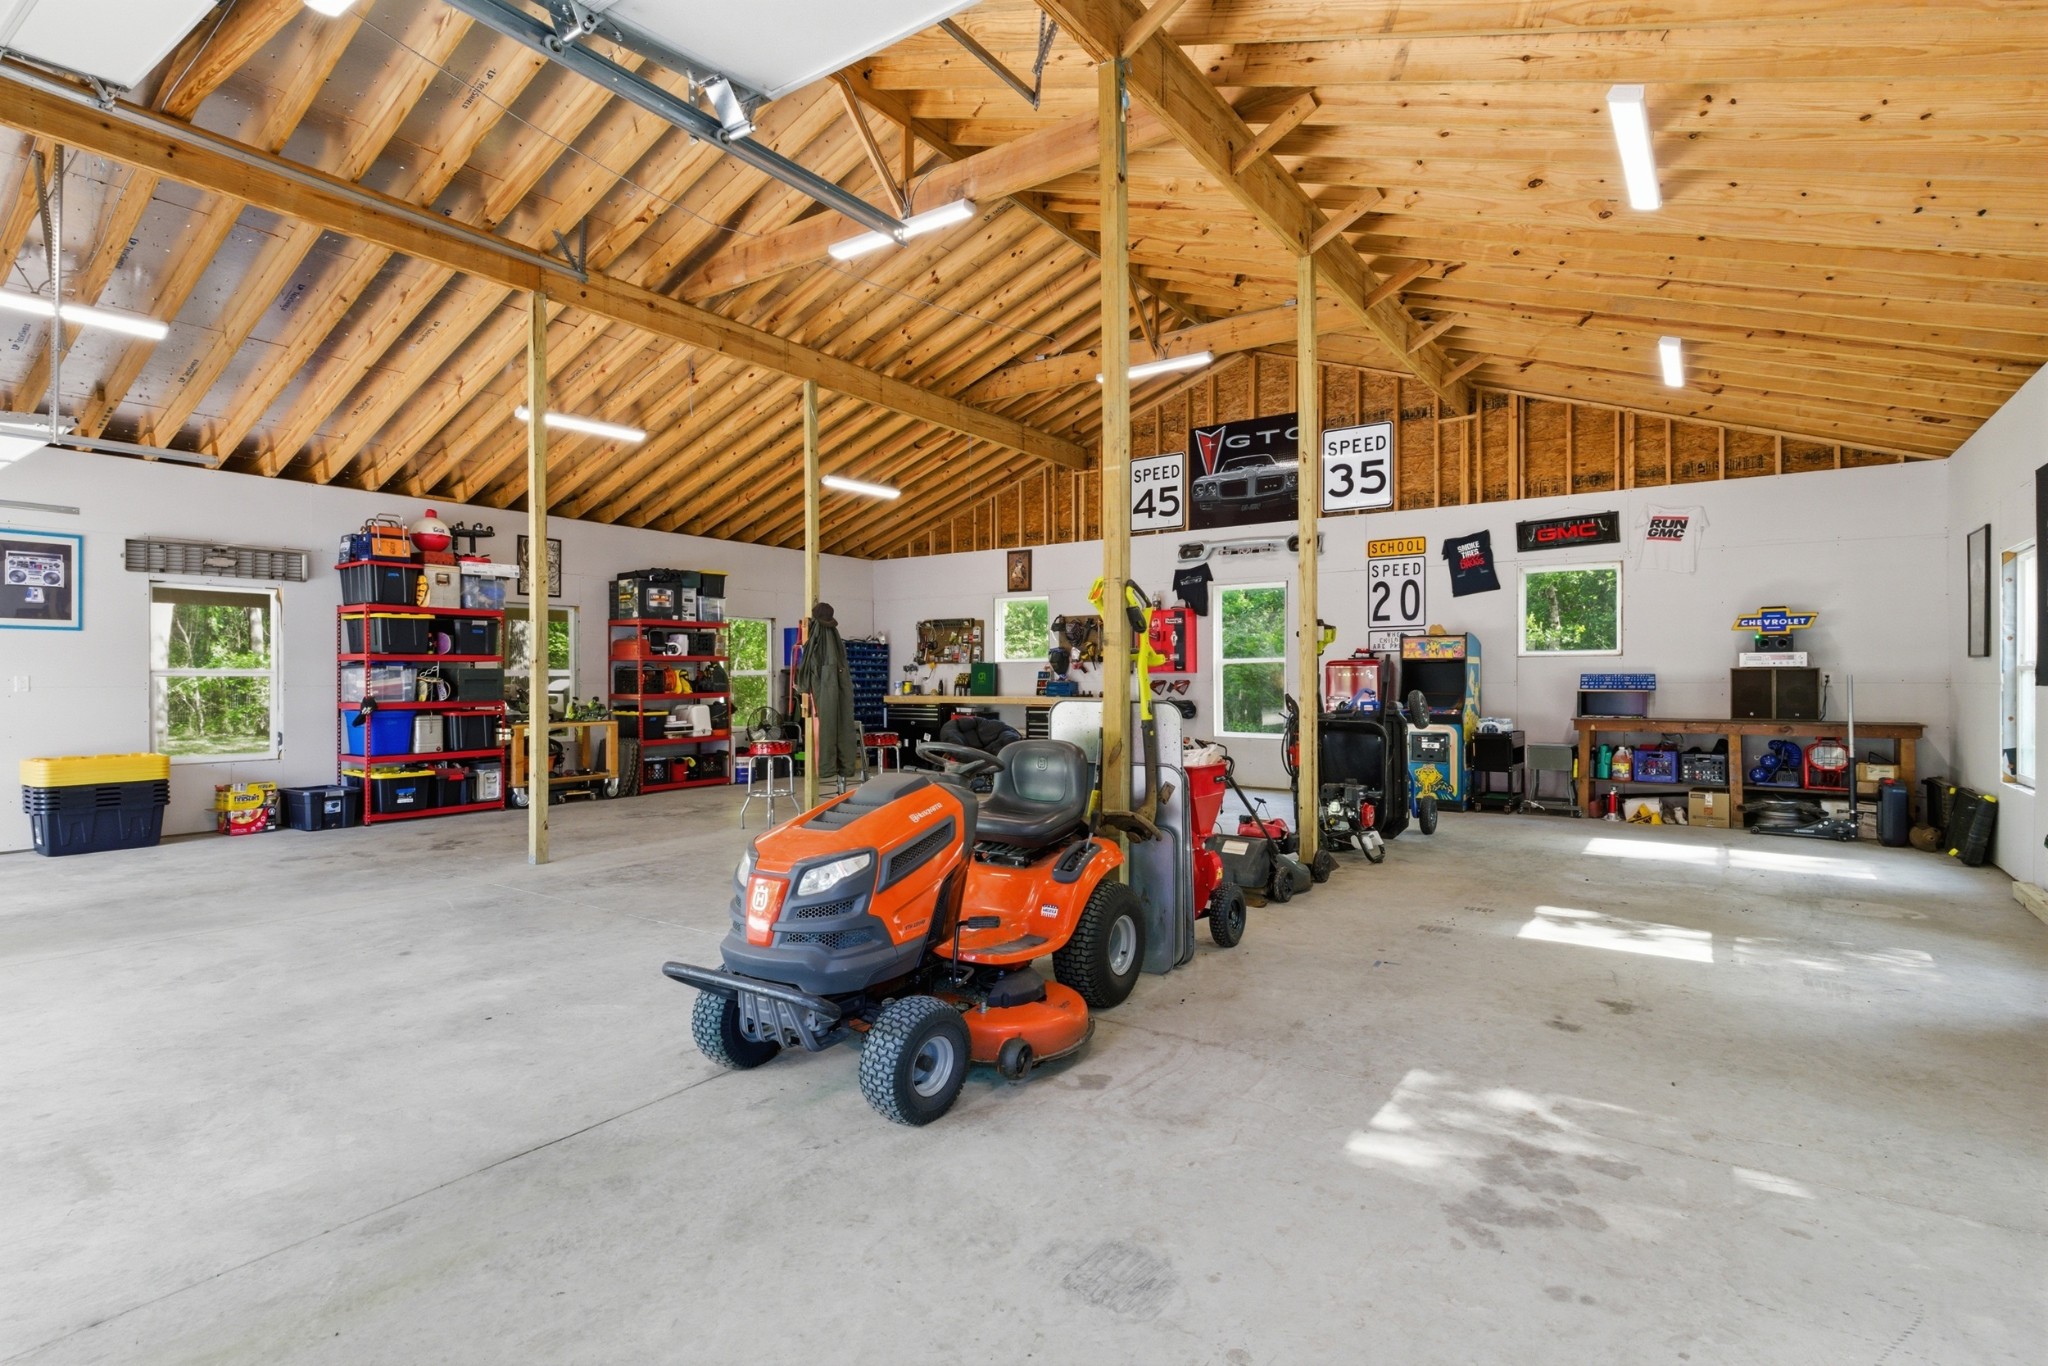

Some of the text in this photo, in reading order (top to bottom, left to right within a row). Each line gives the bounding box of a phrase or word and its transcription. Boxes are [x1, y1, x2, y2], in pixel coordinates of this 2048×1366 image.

[1328, 435, 1387, 457] SPEED
[1133, 464, 1180, 484] SPEED
[1328, 458, 1387, 498] 35
[1132, 485, 1180, 519] 45
[1537, 522, 1598, 543] GMC
[1650, 518, 1689, 530] RUN
[1647, 528, 1686, 539] GMC
[1371, 540, 1423, 554] SCHOOL
[1457, 541, 1480, 553] SMOKE
[1372, 562, 1421, 578] SPEED
[1372, 579, 1421, 622] 20
[1741, 617, 1806, 627] CHEVROLET
